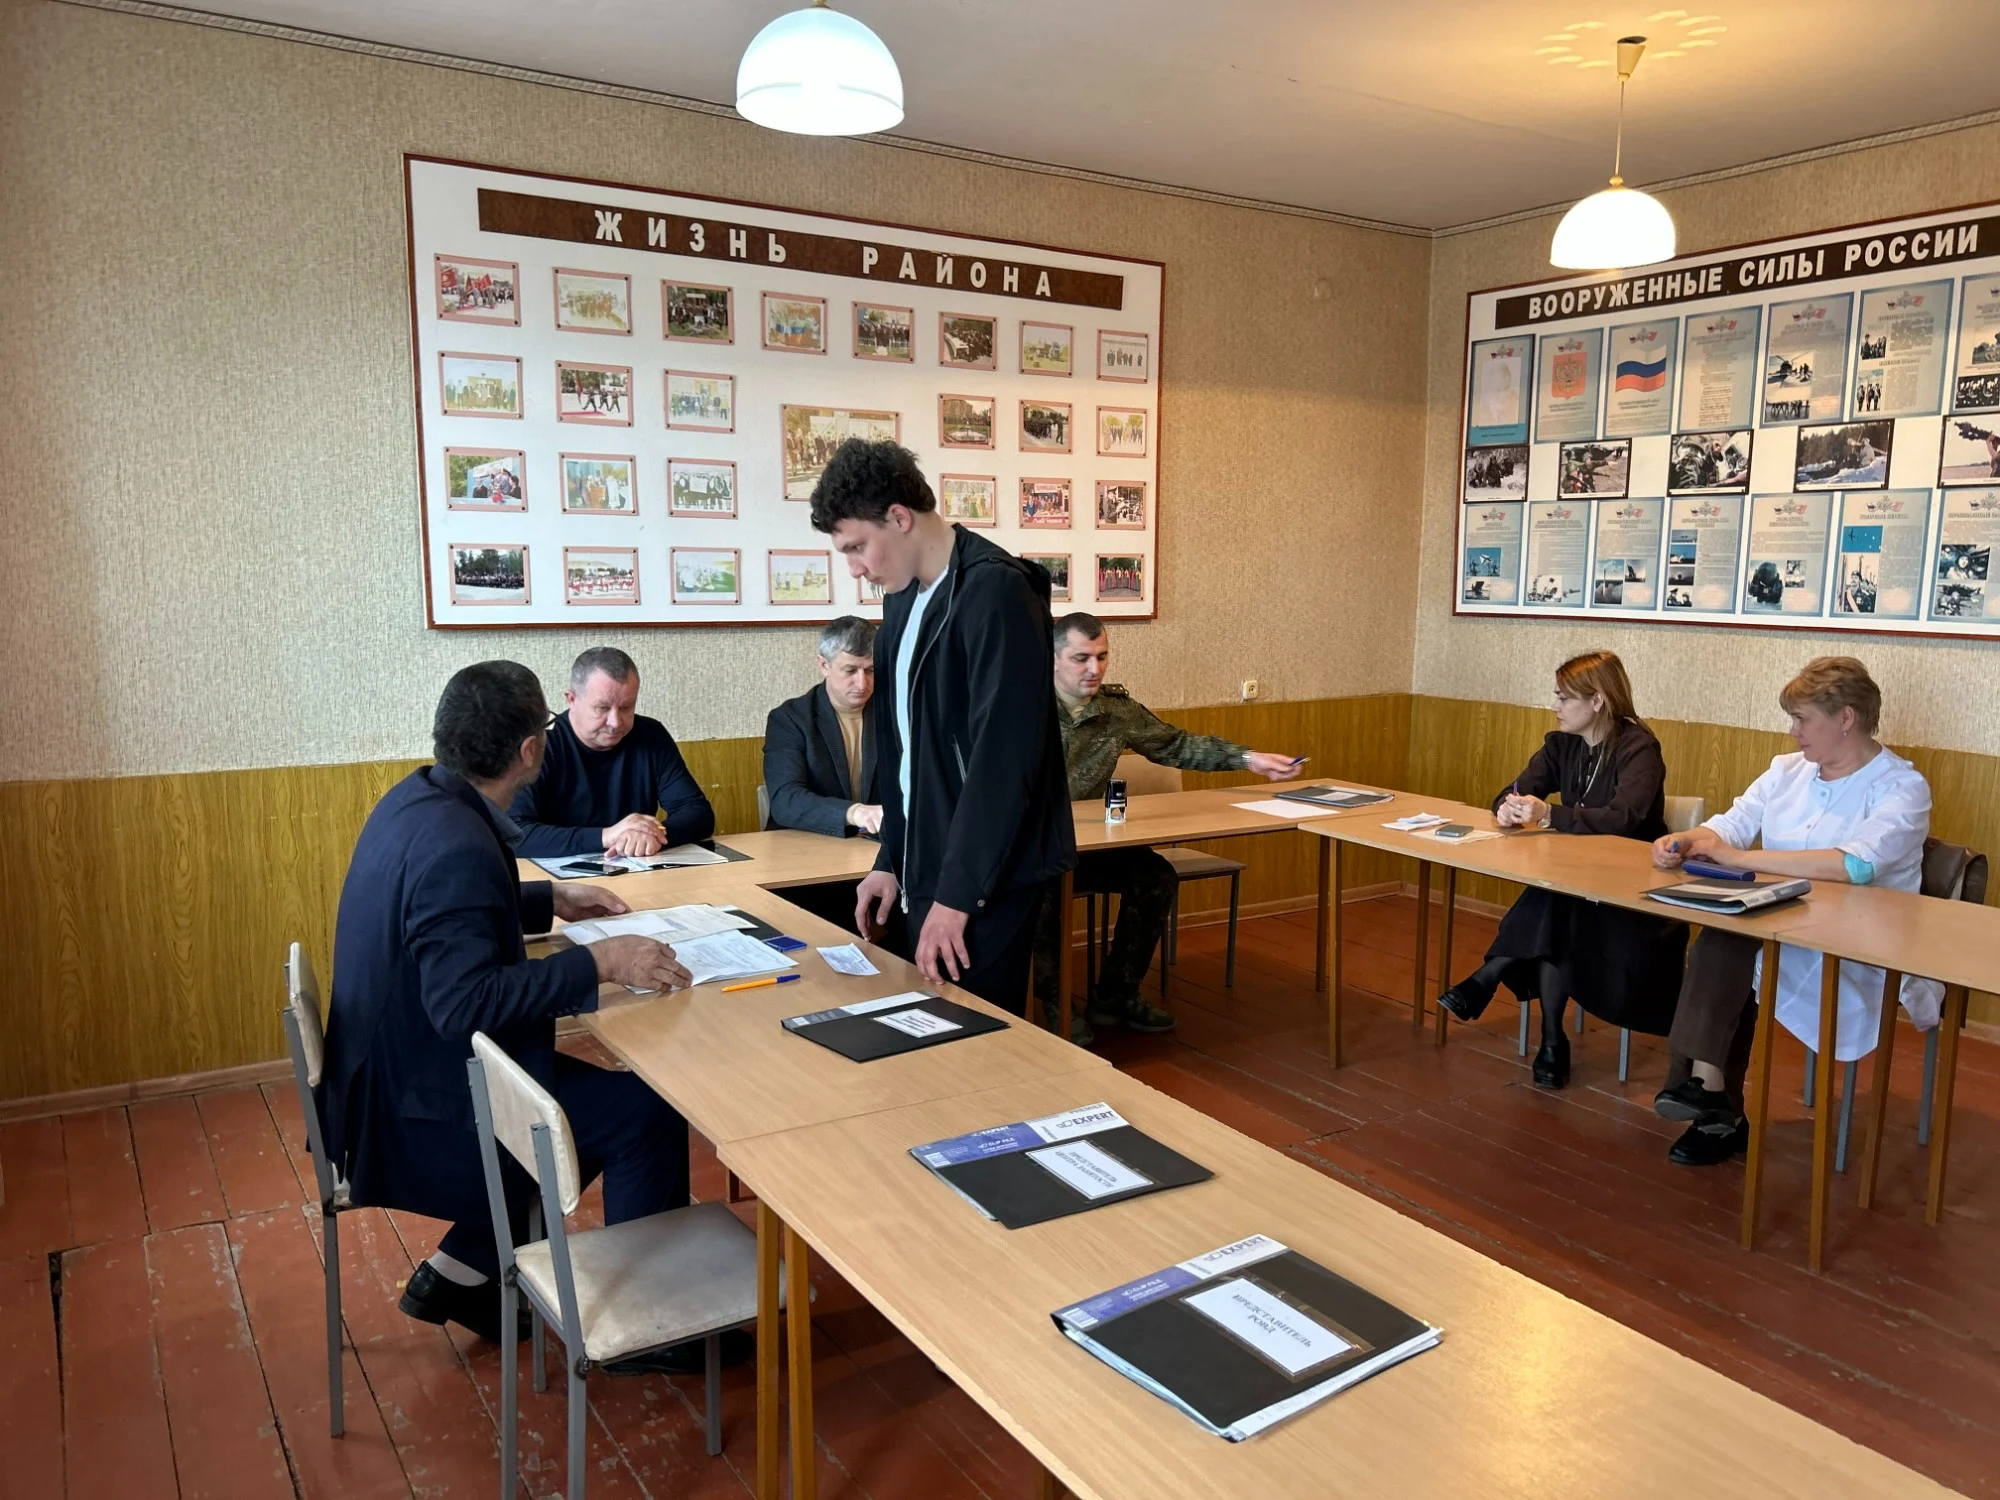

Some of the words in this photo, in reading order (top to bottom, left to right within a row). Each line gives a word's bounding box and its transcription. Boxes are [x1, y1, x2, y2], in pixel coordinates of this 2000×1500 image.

[594, 209, 787, 263] ЖИЗНЬ
[862, 246, 1051, 297] РАЙОНА
[1528, 266, 1723, 320] ВООРУЖЕННЫЕ
[1738, 250, 1825, 287] СИЛЫ
[1844, 224, 1979, 272] РОССИИ
[1073, 1110, 1115, 1125] EXPERT
[1220, 1235, 1268, 1256] EXPERT
[1232, 1294, 1312, 1348] ПРЕДСТАВИТЕЛЬ
[1247, 1314, 1276, 1334] РОВД
